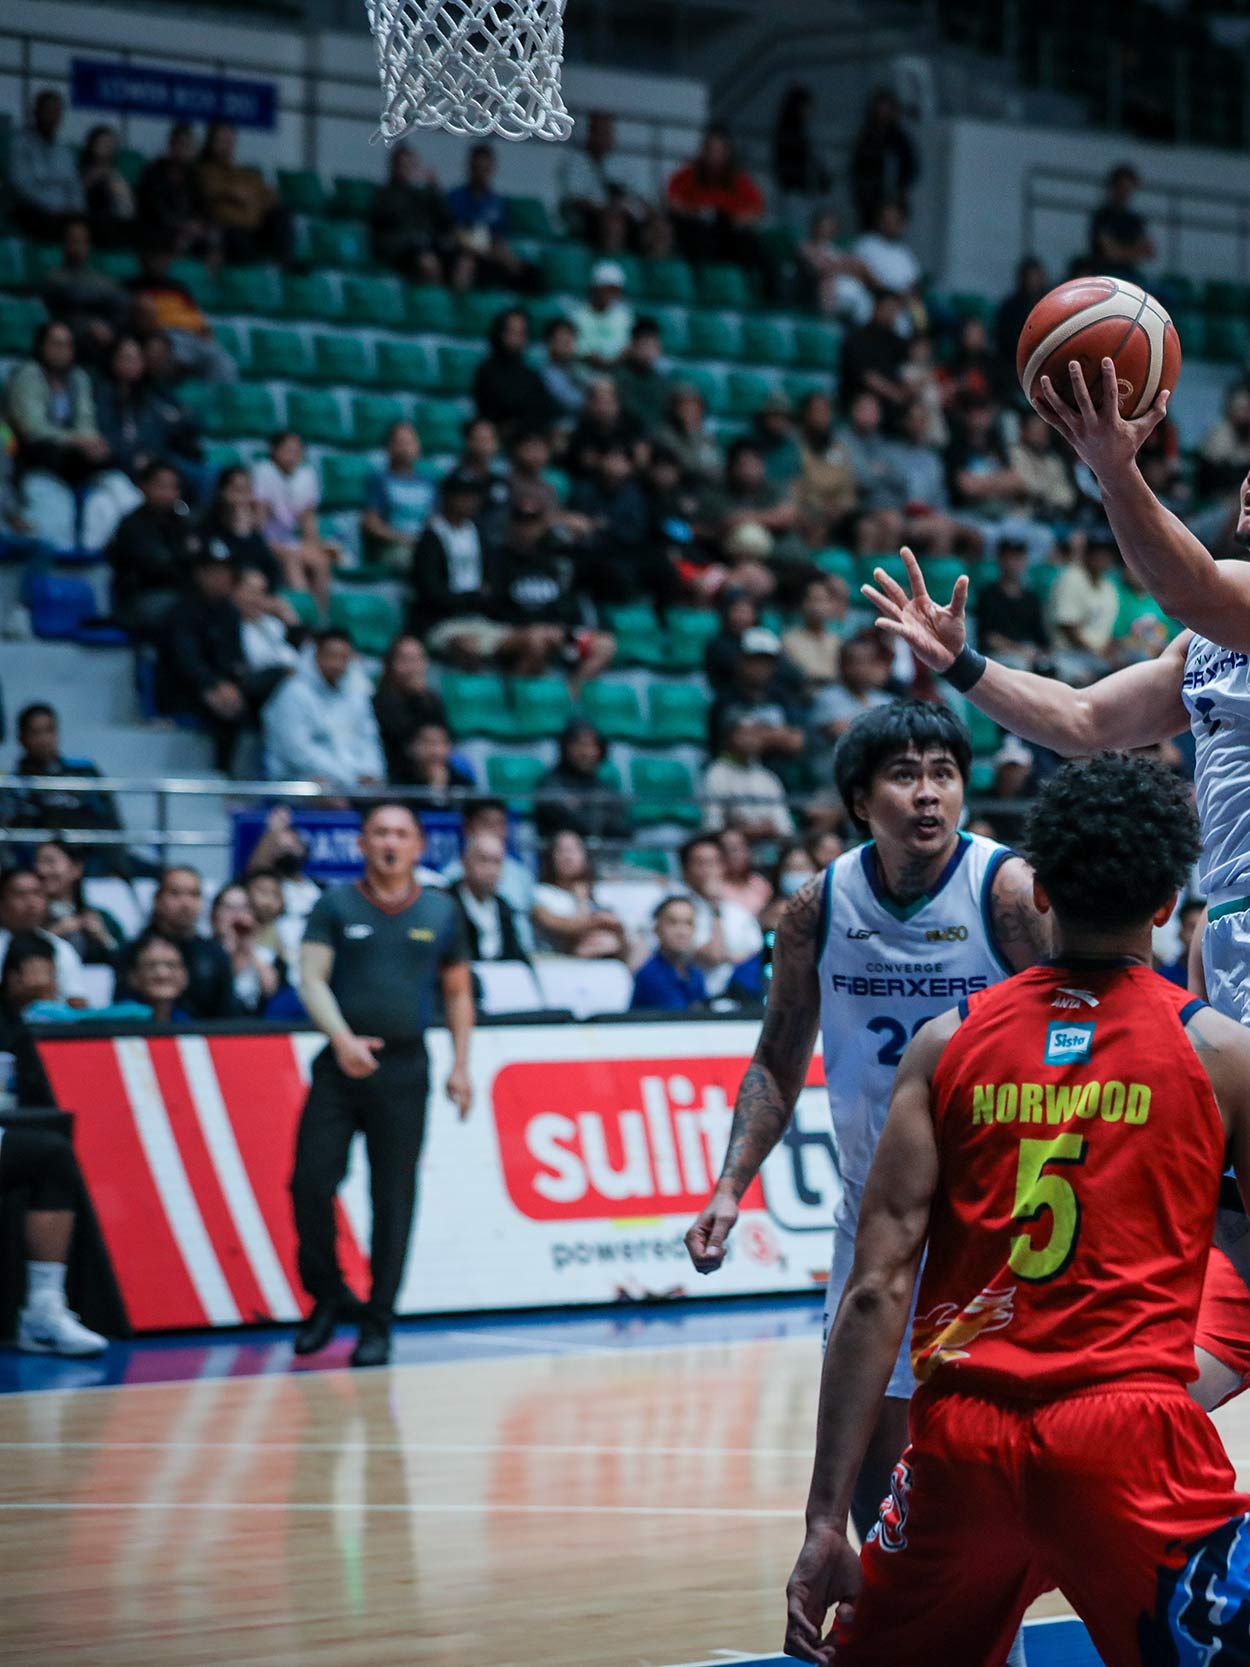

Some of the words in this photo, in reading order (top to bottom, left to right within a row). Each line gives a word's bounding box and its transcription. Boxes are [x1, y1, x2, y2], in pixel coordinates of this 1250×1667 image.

[866, 962, 943, 973] CONVERGE
[525, 1075, 737, 1203] sulit
[972, 1080, 1152, 1125] NORWOOD
[1008, 1132, 1088, 1285] 5
